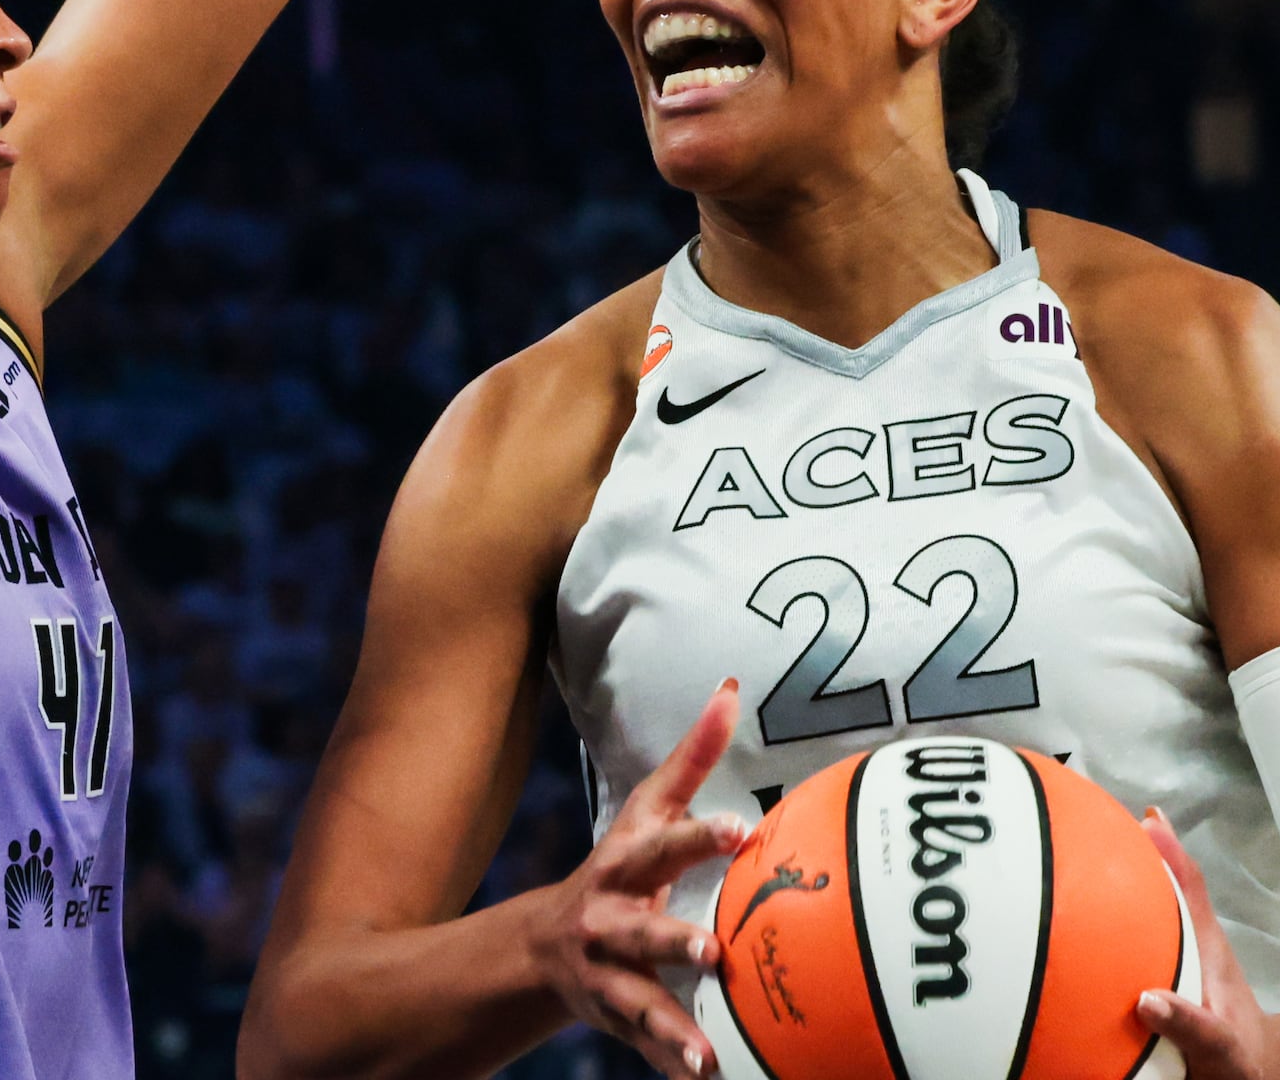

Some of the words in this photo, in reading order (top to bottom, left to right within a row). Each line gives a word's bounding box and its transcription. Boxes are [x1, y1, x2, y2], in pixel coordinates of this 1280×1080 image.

[673, 394, 1075, 531] ACES
[29, 615, 115, 801] 41
[746, 534, 1040, 747] 22
[898, 744, 994, 1008] Wilson
